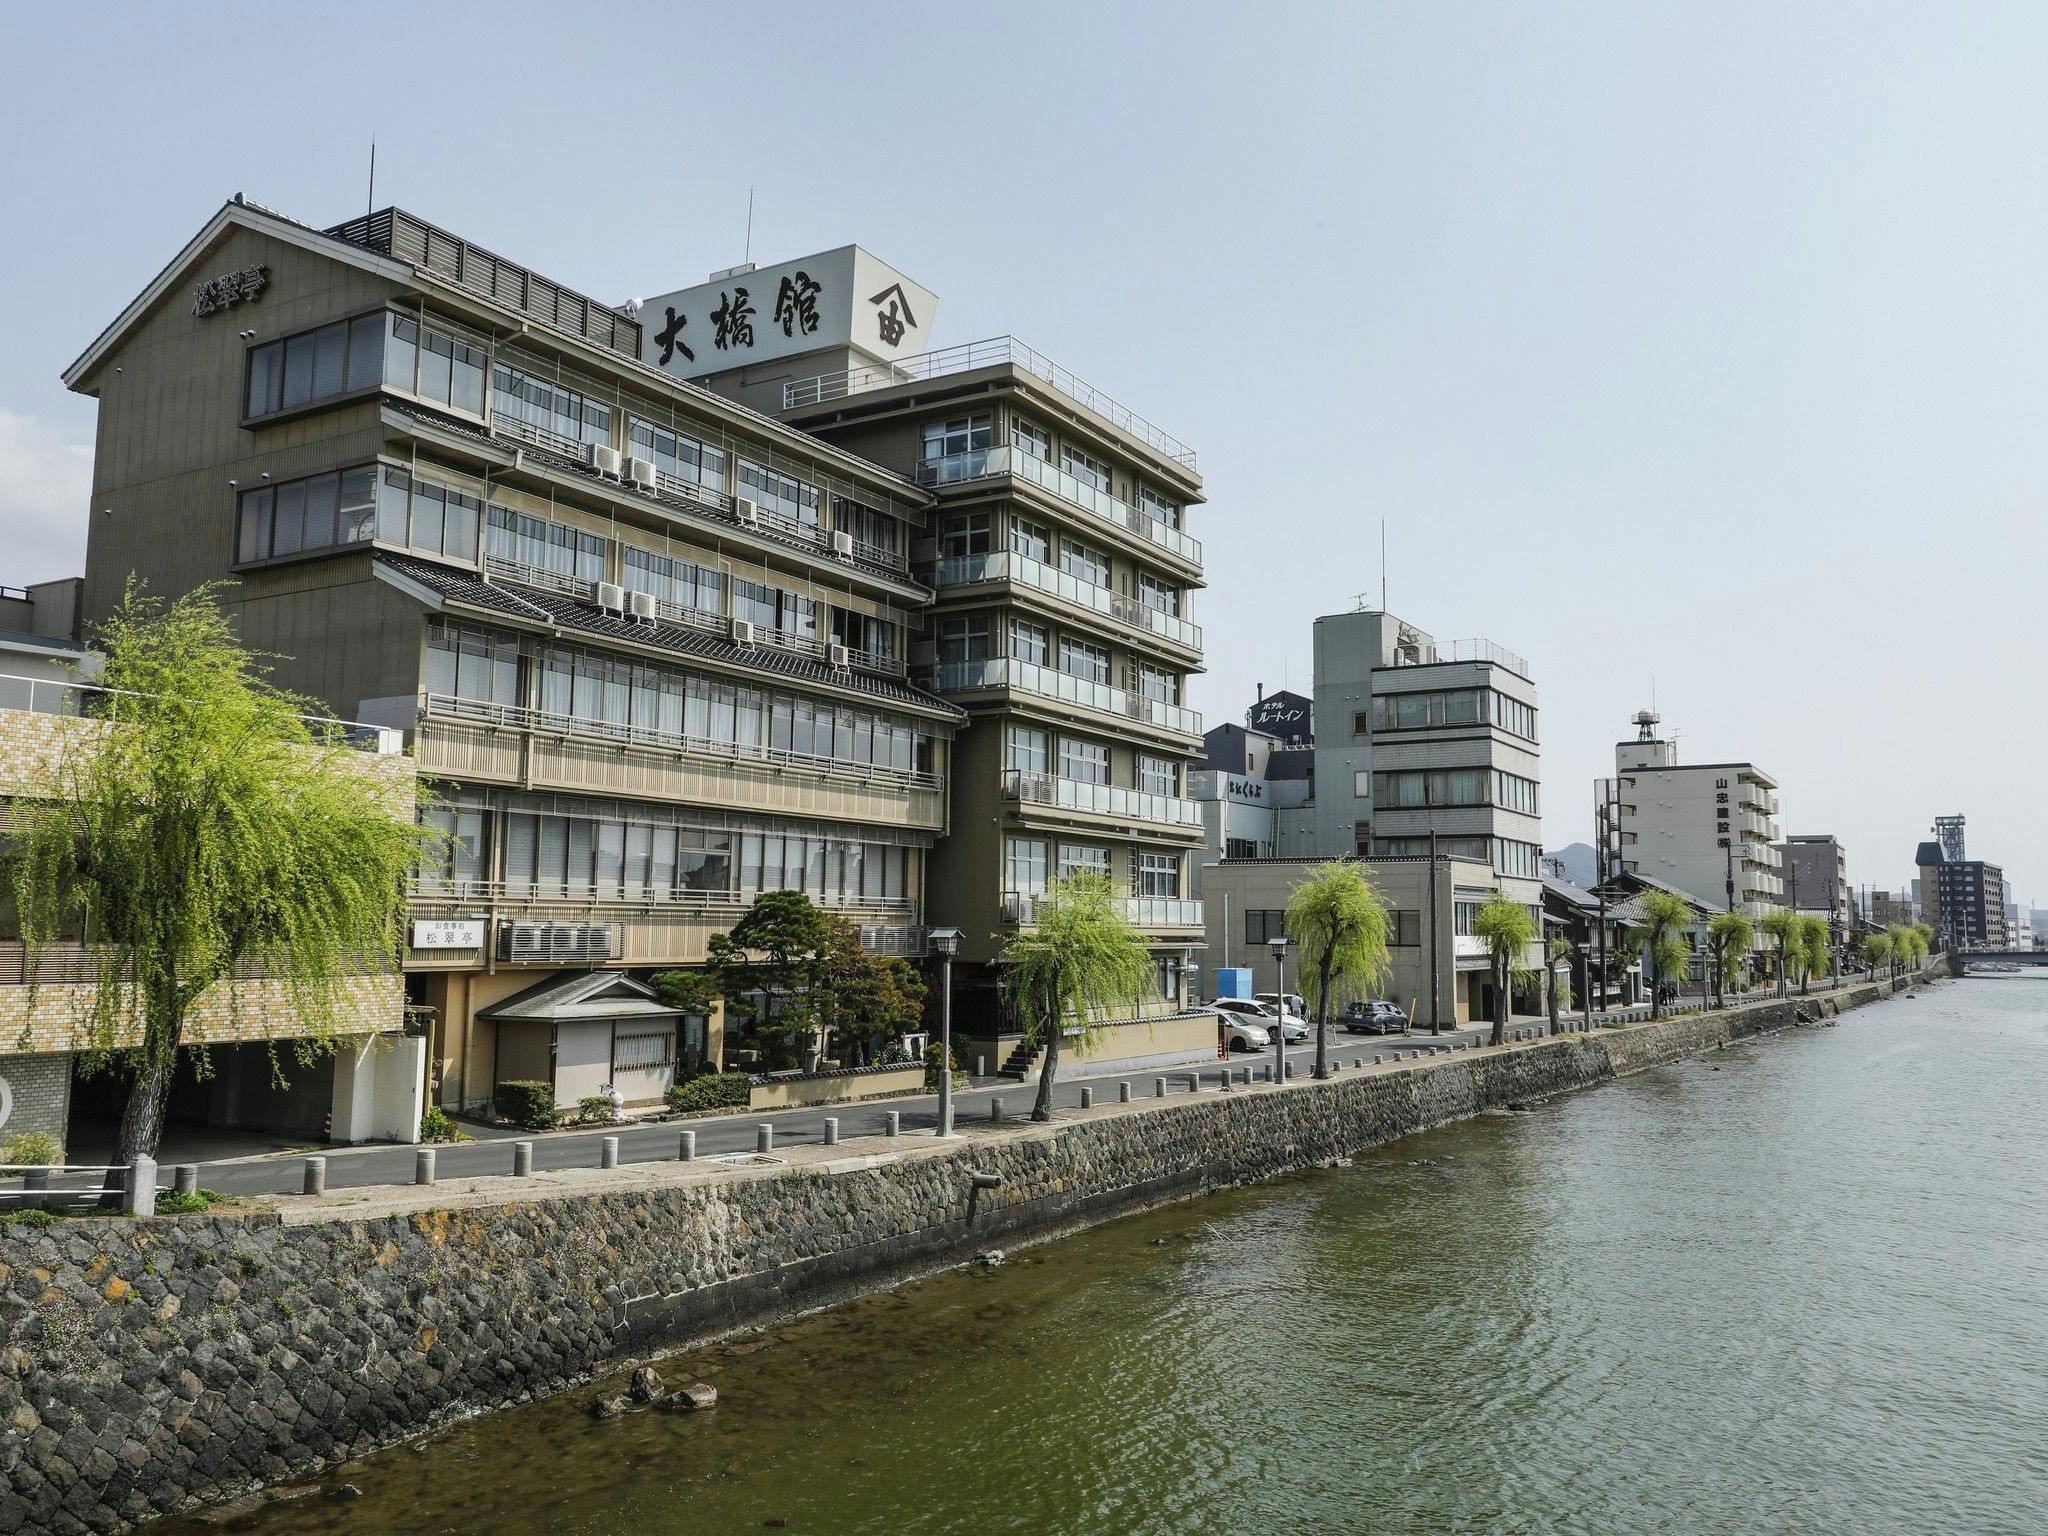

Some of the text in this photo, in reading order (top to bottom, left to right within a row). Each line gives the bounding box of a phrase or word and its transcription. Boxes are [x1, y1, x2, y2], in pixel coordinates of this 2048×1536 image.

[654, 271, 822, 366] 大橋館
[1262, 702, 1285, 710] ホテル
[1256, 710, 1304, 723] ルートイン
[435, 922, 465, 930] お食事処
[426, 931, 473, 945] 松翠亭
